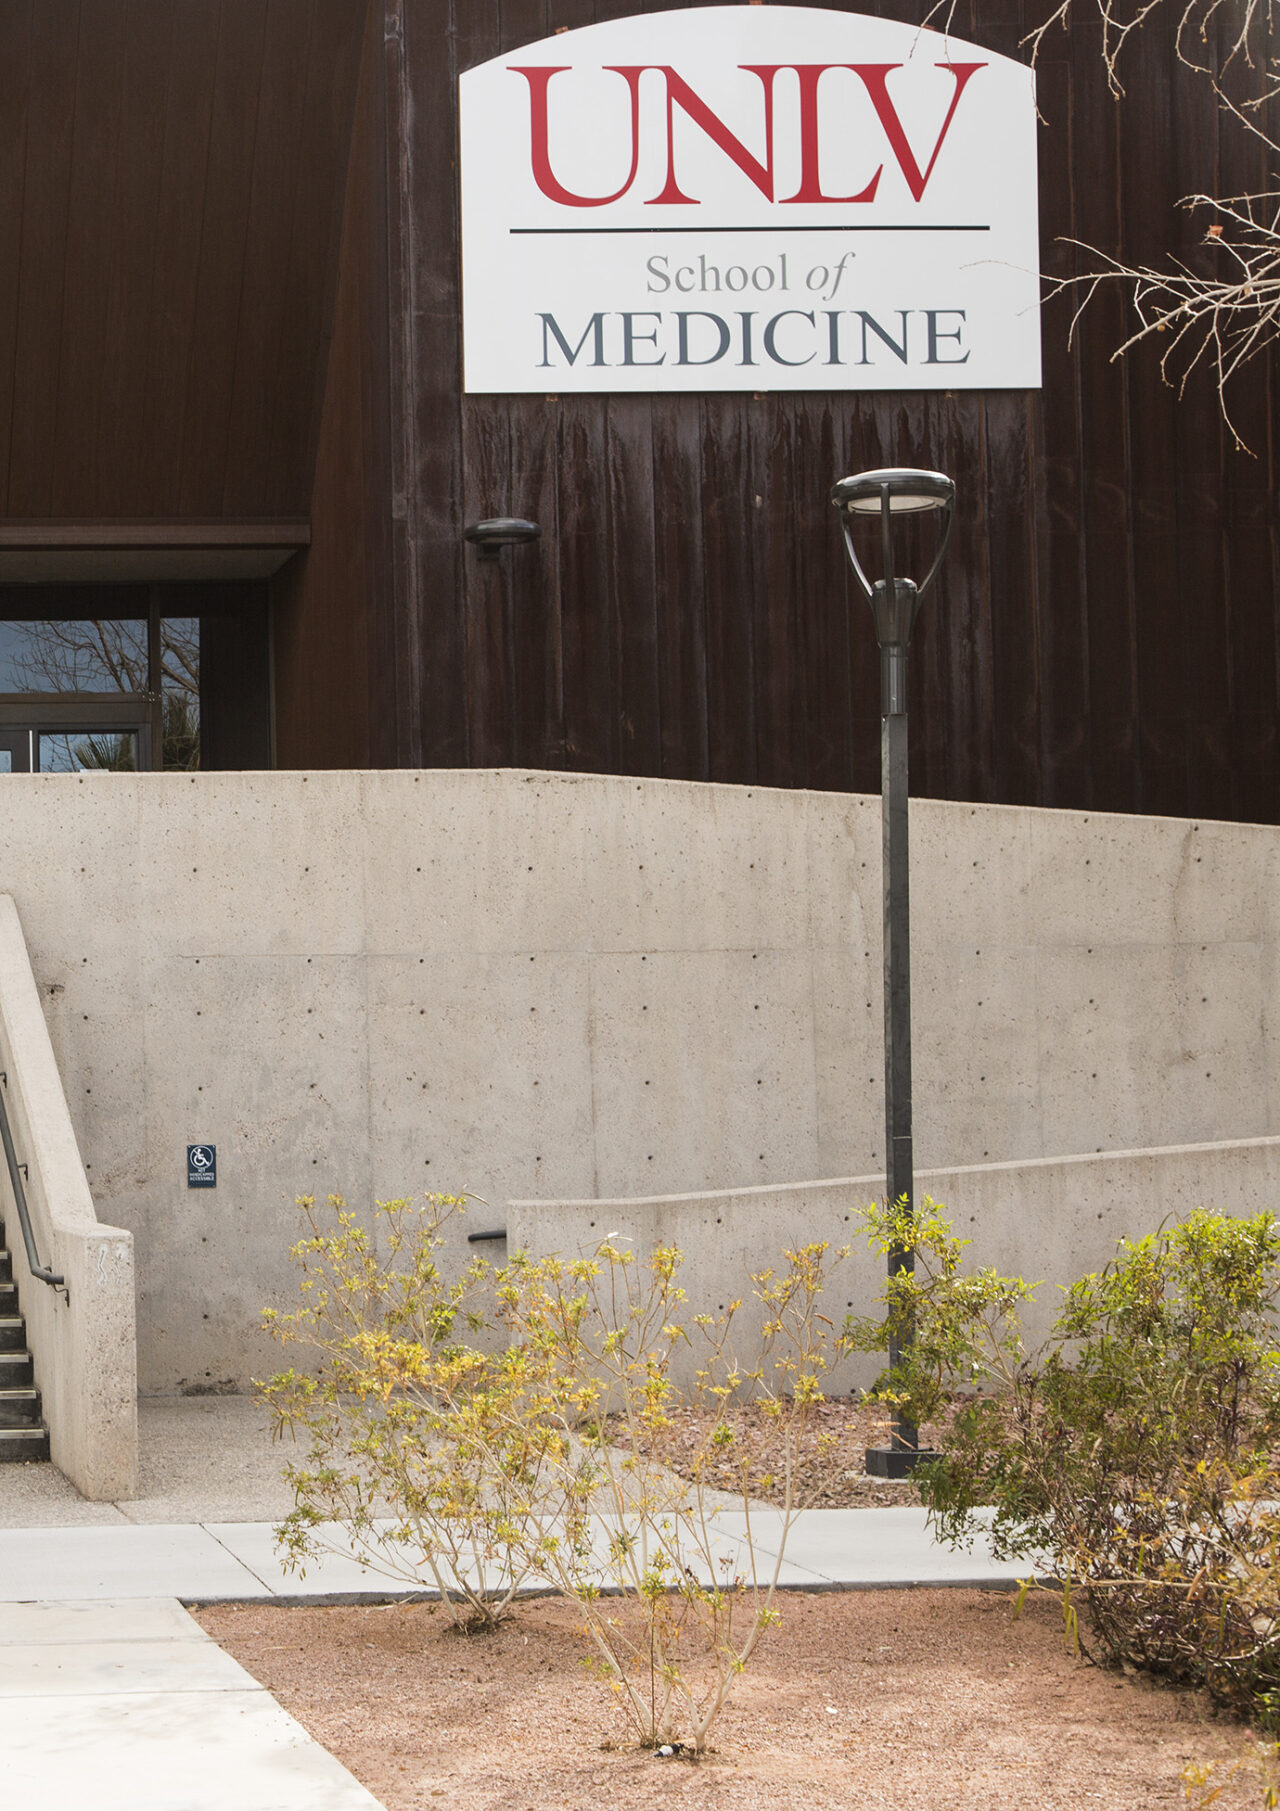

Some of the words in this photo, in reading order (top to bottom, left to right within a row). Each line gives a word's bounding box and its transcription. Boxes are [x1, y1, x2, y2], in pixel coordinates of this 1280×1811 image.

[506, 62, 989, 208] UNLV
[647, 254, 788, 294] School
[806, 251, 856, 301] of
[535, 309, 972, 368] MEDICINE
